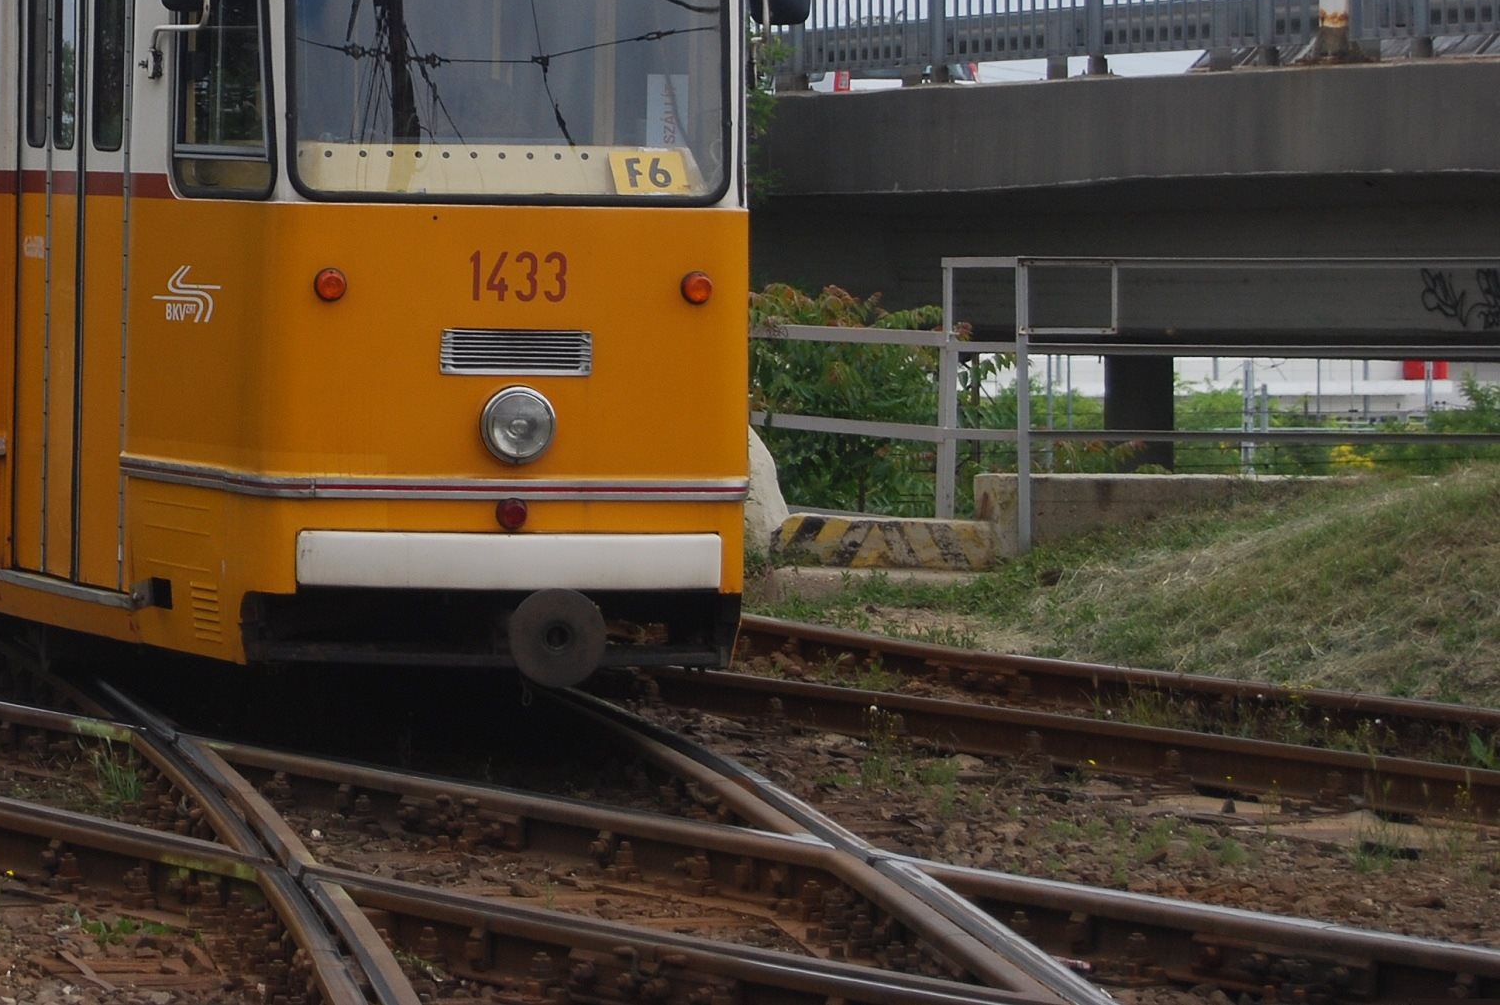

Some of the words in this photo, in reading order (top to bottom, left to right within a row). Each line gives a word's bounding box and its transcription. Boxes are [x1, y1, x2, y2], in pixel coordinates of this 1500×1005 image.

[625, 158, 672, 188] F6
[469, 250, 567, 302] 1433
[165, 303, 185, 321] BKV
